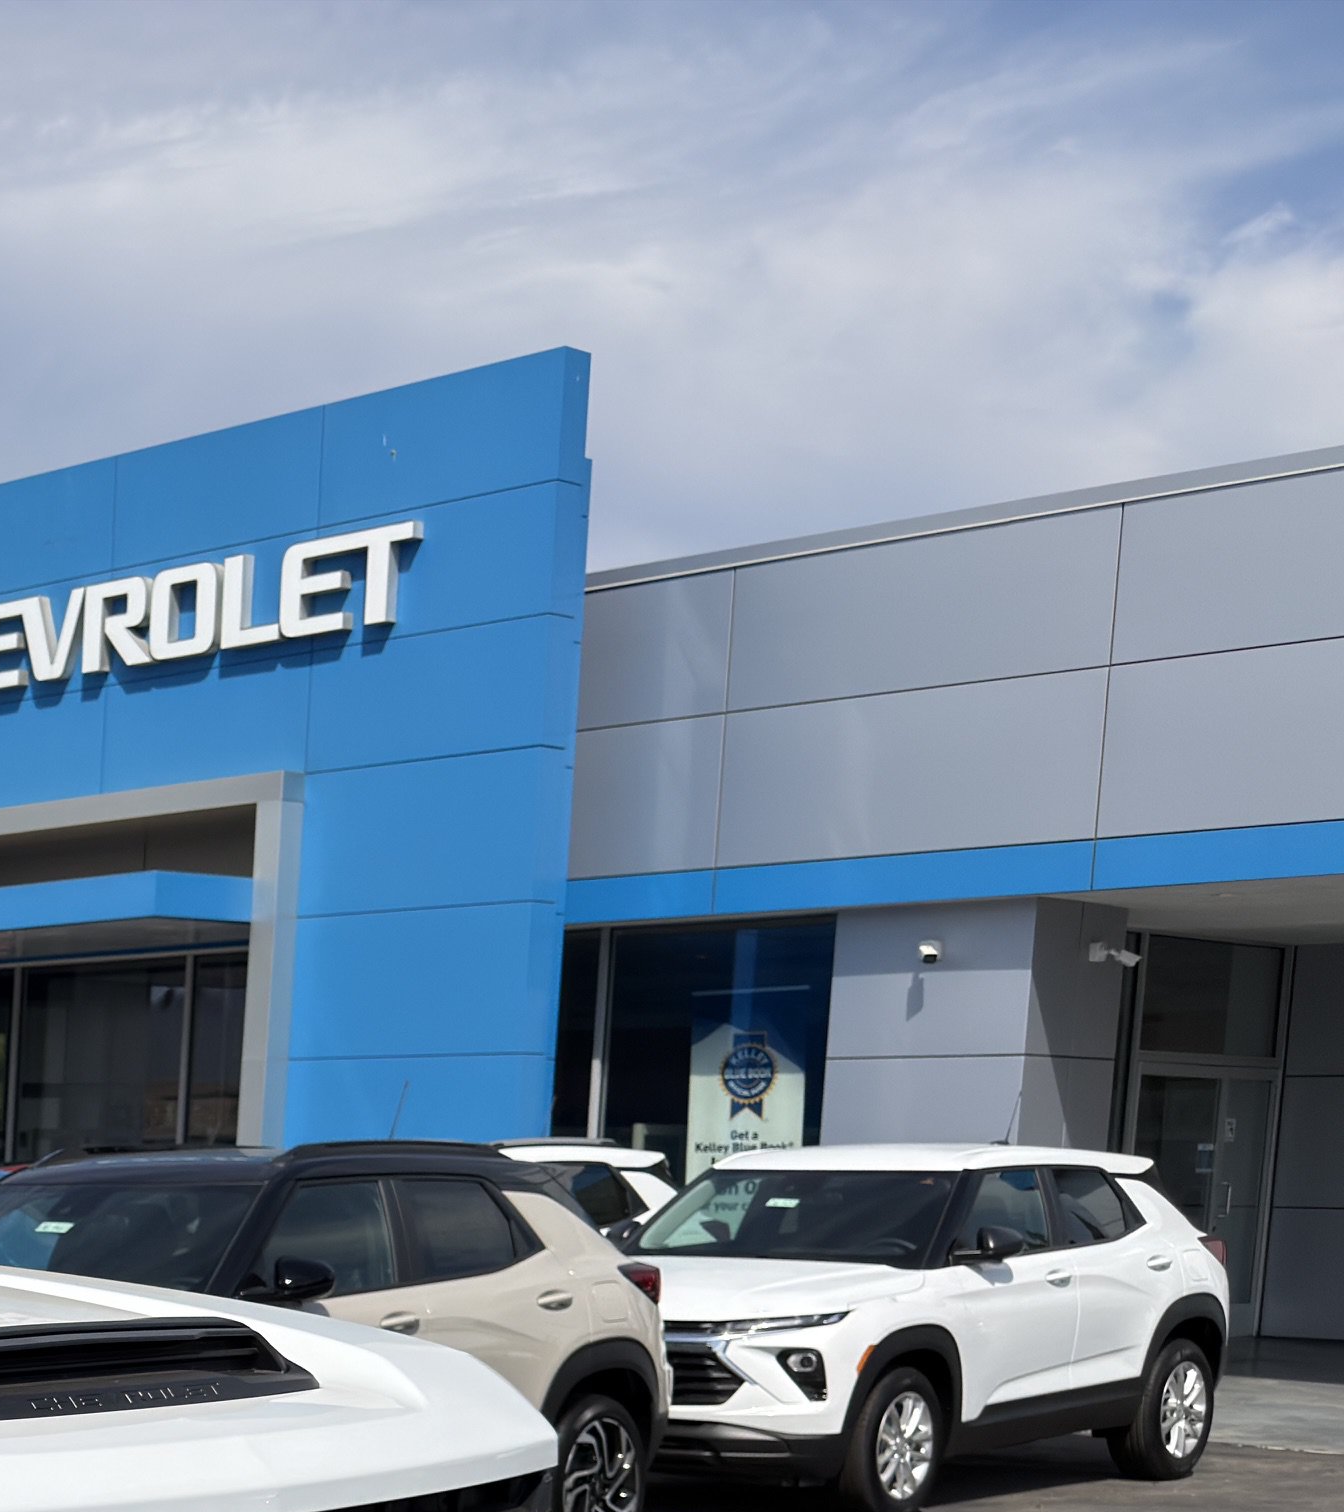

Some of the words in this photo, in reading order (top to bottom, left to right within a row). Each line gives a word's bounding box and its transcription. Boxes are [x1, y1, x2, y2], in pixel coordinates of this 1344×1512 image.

[730, 1129, 749, 1140] Get
[751, 1132, 759, 1140] a
[694, 1141, 729, 1154] Kelley
[732, 1141, 758, 1153] Blue
